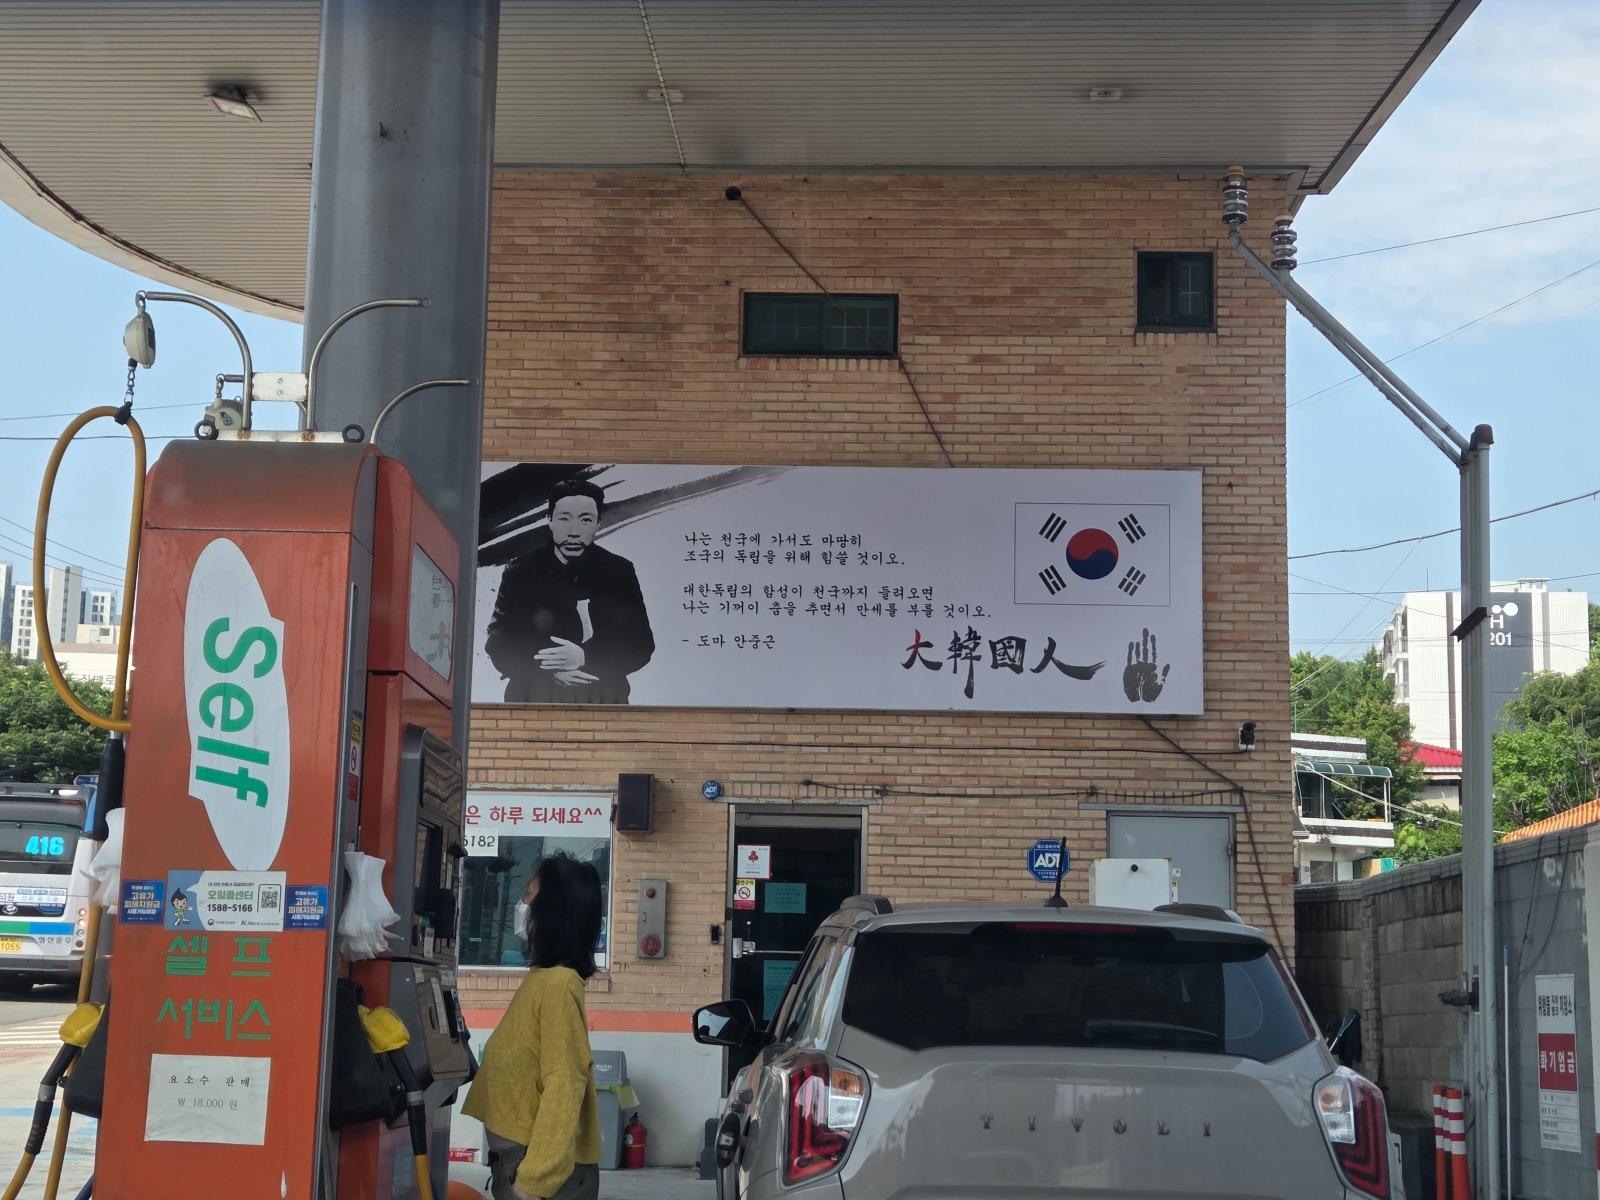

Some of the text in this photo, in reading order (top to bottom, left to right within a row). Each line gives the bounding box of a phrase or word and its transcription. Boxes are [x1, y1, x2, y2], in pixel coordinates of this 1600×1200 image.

[685, 532, 862, 548] 나는 천국에 가서도 마땅히
[684, 548, 905, 566] 조국의 독립을 위해 힘쓸 것이오.
[683, 583, 933, 601] 대한독립의 함성이 천국까지 들려오면
[683, 600, 992, 619] 나는 기꺼이 춤을 추면서 만세를 부를 것이오.
[697, 634, 726, 648] 도마
[734, 634, 776, 649] 안중근
[900, 625, 1107, 699] 大韓國人
[195, 617, 278, 808] Self
[464, 805, 602, 825] 은 하루 되세요^^
[26, 836, 64, 856] 416
[1034, 852, 1061, 868] ADT
[131, 891, 155, 901] 고유가
[207, 889, 254, 901] 오일콜센터
[295, 897, 318, 906] 고유가
[207, 903, 253, 913] 1588-5166
[156, 997, 272, 1040] 서비스
[1540, 1050, 1576, 1074] 화기엄금
[168, 1075, 251, 1088] 요소수 판매
[228, 1099, 239, 1111] 원
[978, 1113, 1214, 1138] TIVOLI
